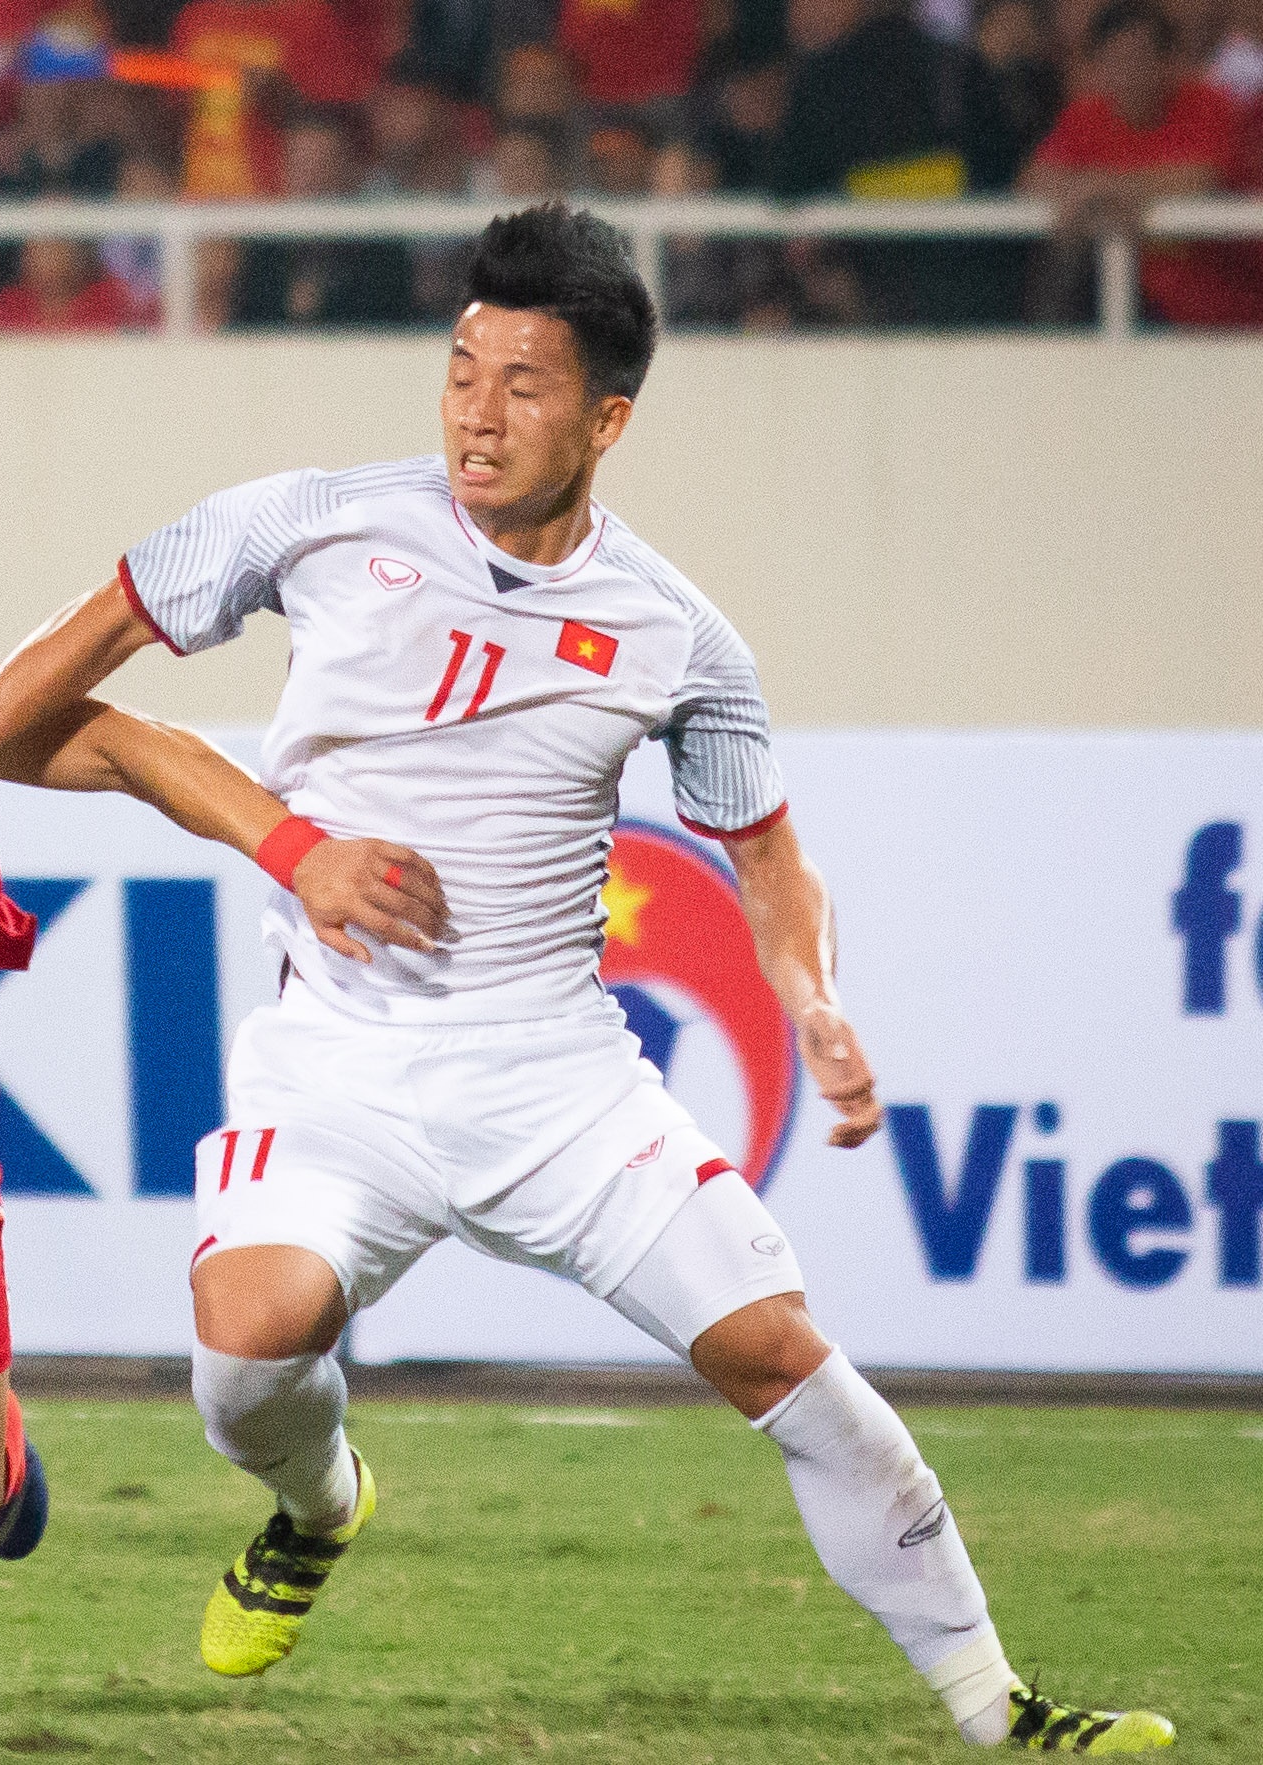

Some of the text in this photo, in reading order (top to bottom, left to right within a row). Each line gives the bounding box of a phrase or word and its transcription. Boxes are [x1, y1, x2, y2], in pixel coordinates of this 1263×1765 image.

[424, 628, 507, 722] 11
[1171, 820, 1263, 1018] f
[219, 1127, 277, 1194] 11
[884, 1100, 1263, 1290] Viet
